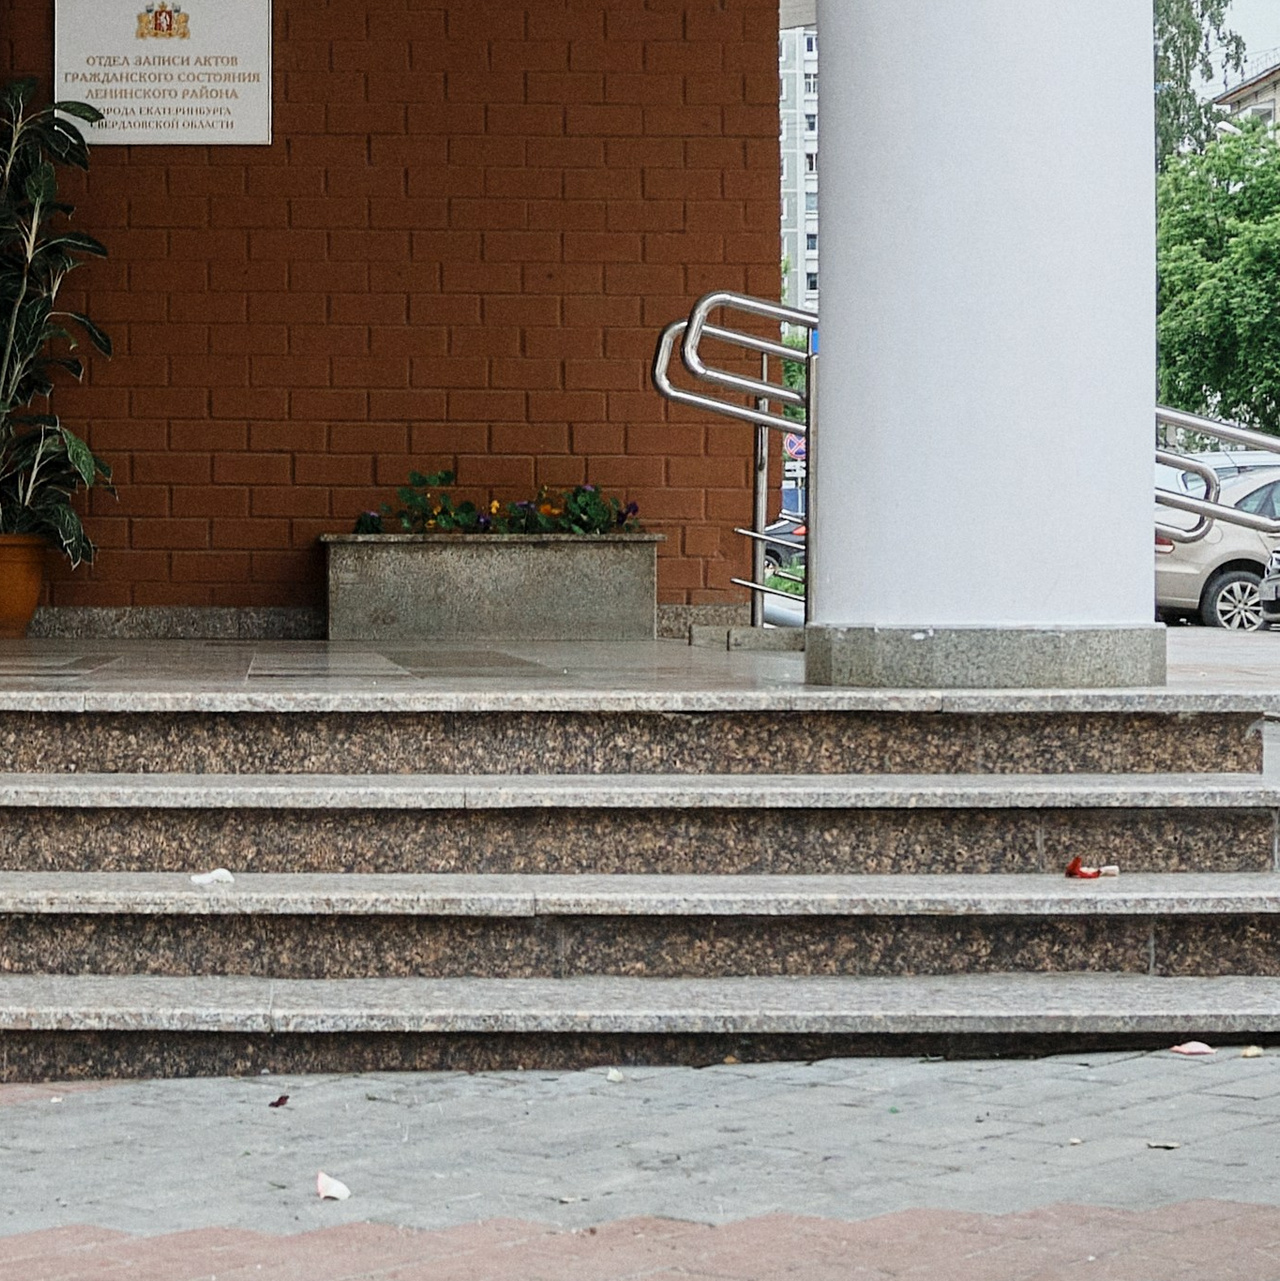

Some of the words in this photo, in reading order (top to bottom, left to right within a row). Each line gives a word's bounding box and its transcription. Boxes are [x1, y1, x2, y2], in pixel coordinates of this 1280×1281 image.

[86, 55, 130, 67] ОТДЕЛ
[135, 55, 190, 66] ЗАПИСИ
[194, 55, 238, 66] АКТОВ
[64, 72, 174, 84] ГРАЖДАНСКОГО
[177, 72, 261, 83] СОСТОЯНИЯ
[85, 88, 178, 100] ЛЕНИНСКОГО
[182, 86, 239, 100] РАЙОНА
[98, 106, 136, 117] ОРОДА
[139, 106, 232, 116] ЕКАТЕРИНБУРГА
[182, 120, 234, 130] ОБЛАСТИ
